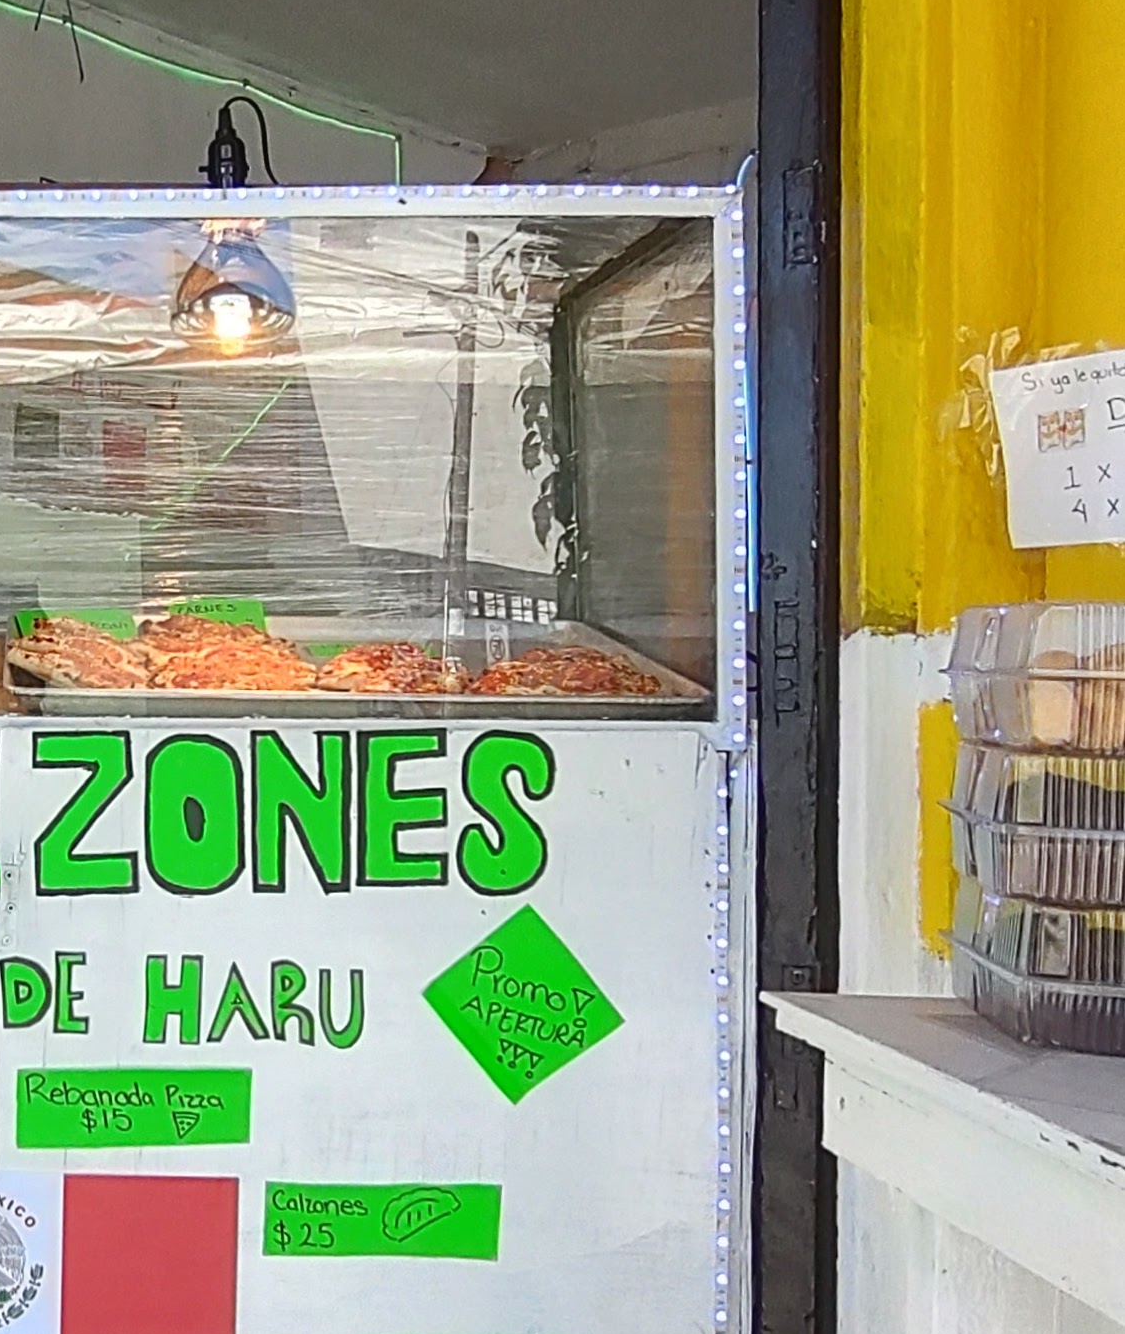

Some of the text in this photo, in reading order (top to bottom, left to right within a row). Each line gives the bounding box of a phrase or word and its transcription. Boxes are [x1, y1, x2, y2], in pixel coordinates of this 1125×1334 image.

[1072, 498, 1088, 524] 4
[0, 951, 365, 1050] DE HARU
[459, 994, 587, 1049] APERTURA
[25, 1072, 225, 1111] Rebanada Pizza
[80, 1108, 133, 1134] $15
[272, 1189, 369, 1217] Calzones
